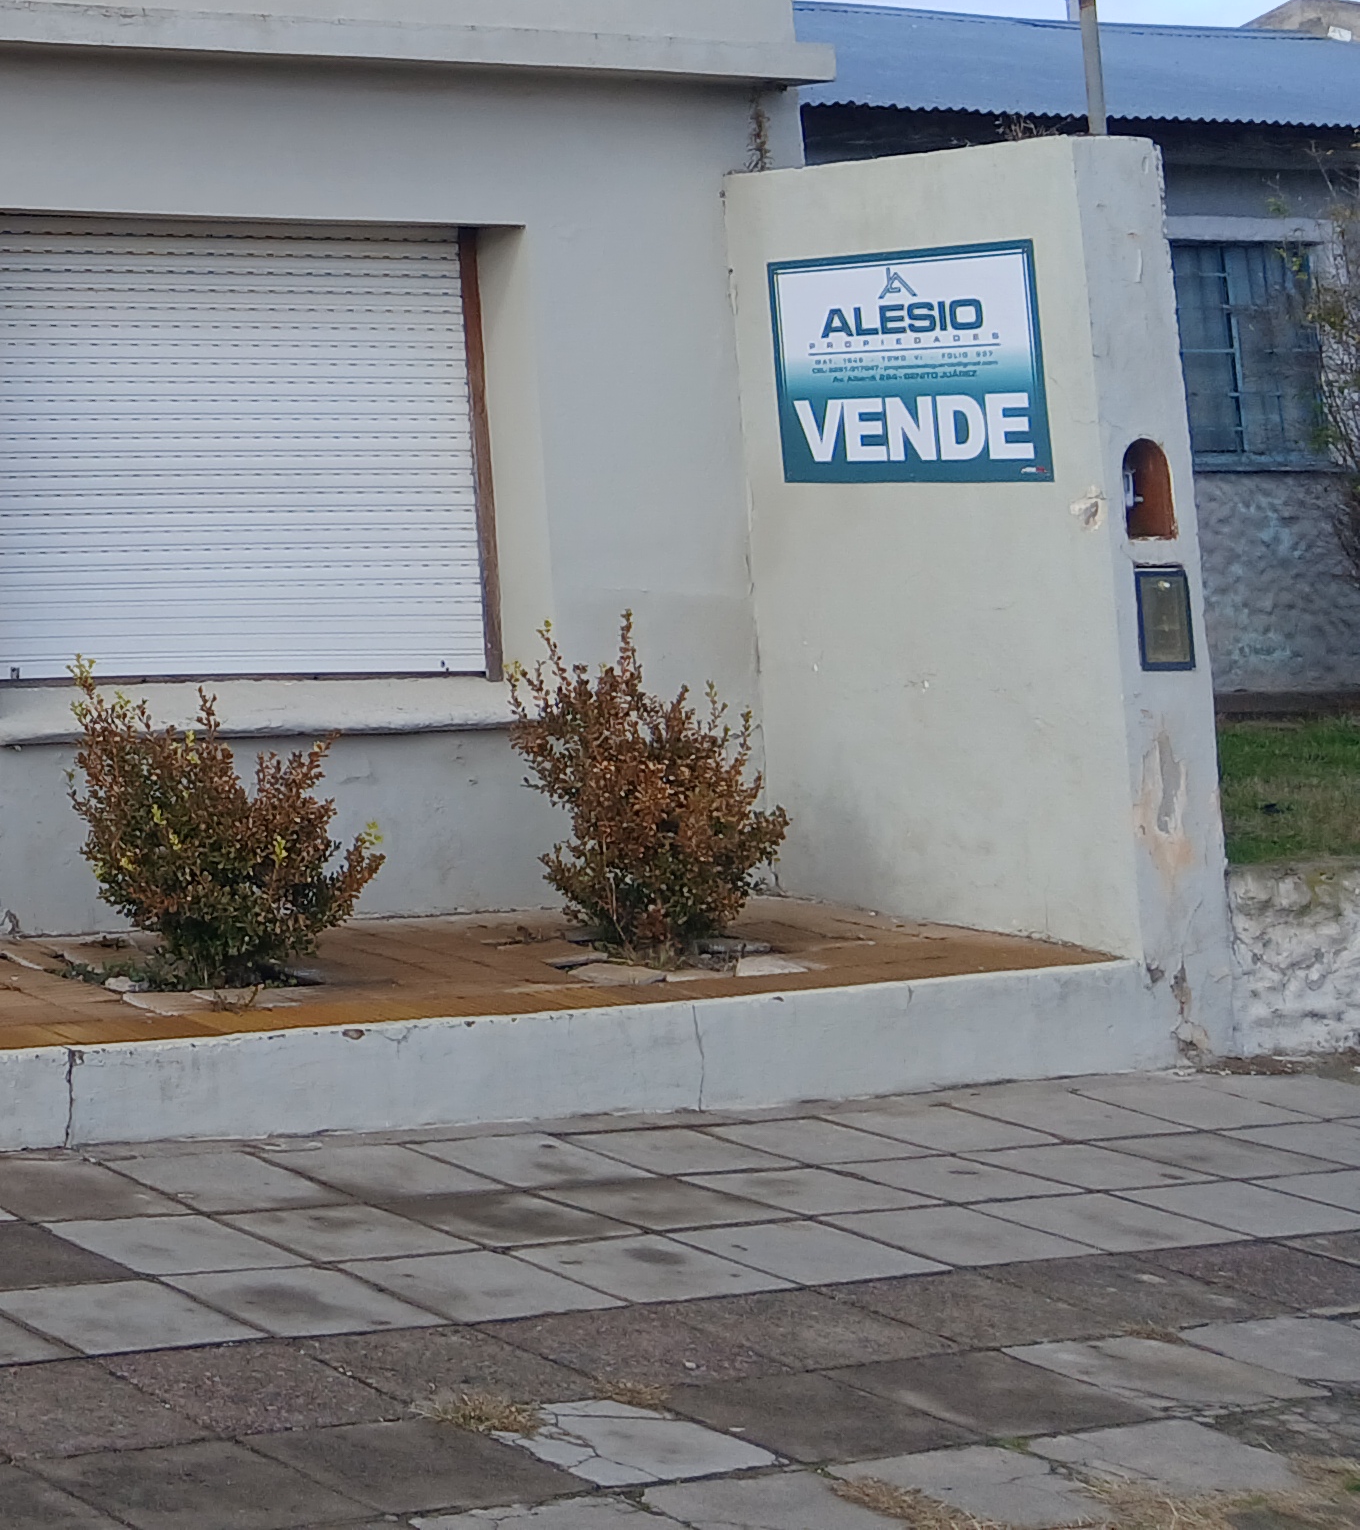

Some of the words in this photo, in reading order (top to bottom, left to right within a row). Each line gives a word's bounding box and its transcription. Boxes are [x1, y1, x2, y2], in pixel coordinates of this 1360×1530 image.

[821, 298, 983, 339] ALESIO
[808, 332, 1000, 350] PROPIEDADES
[941, 351, 969, 360] FOLIO
[793, 392, 1035, 462] VENDE
